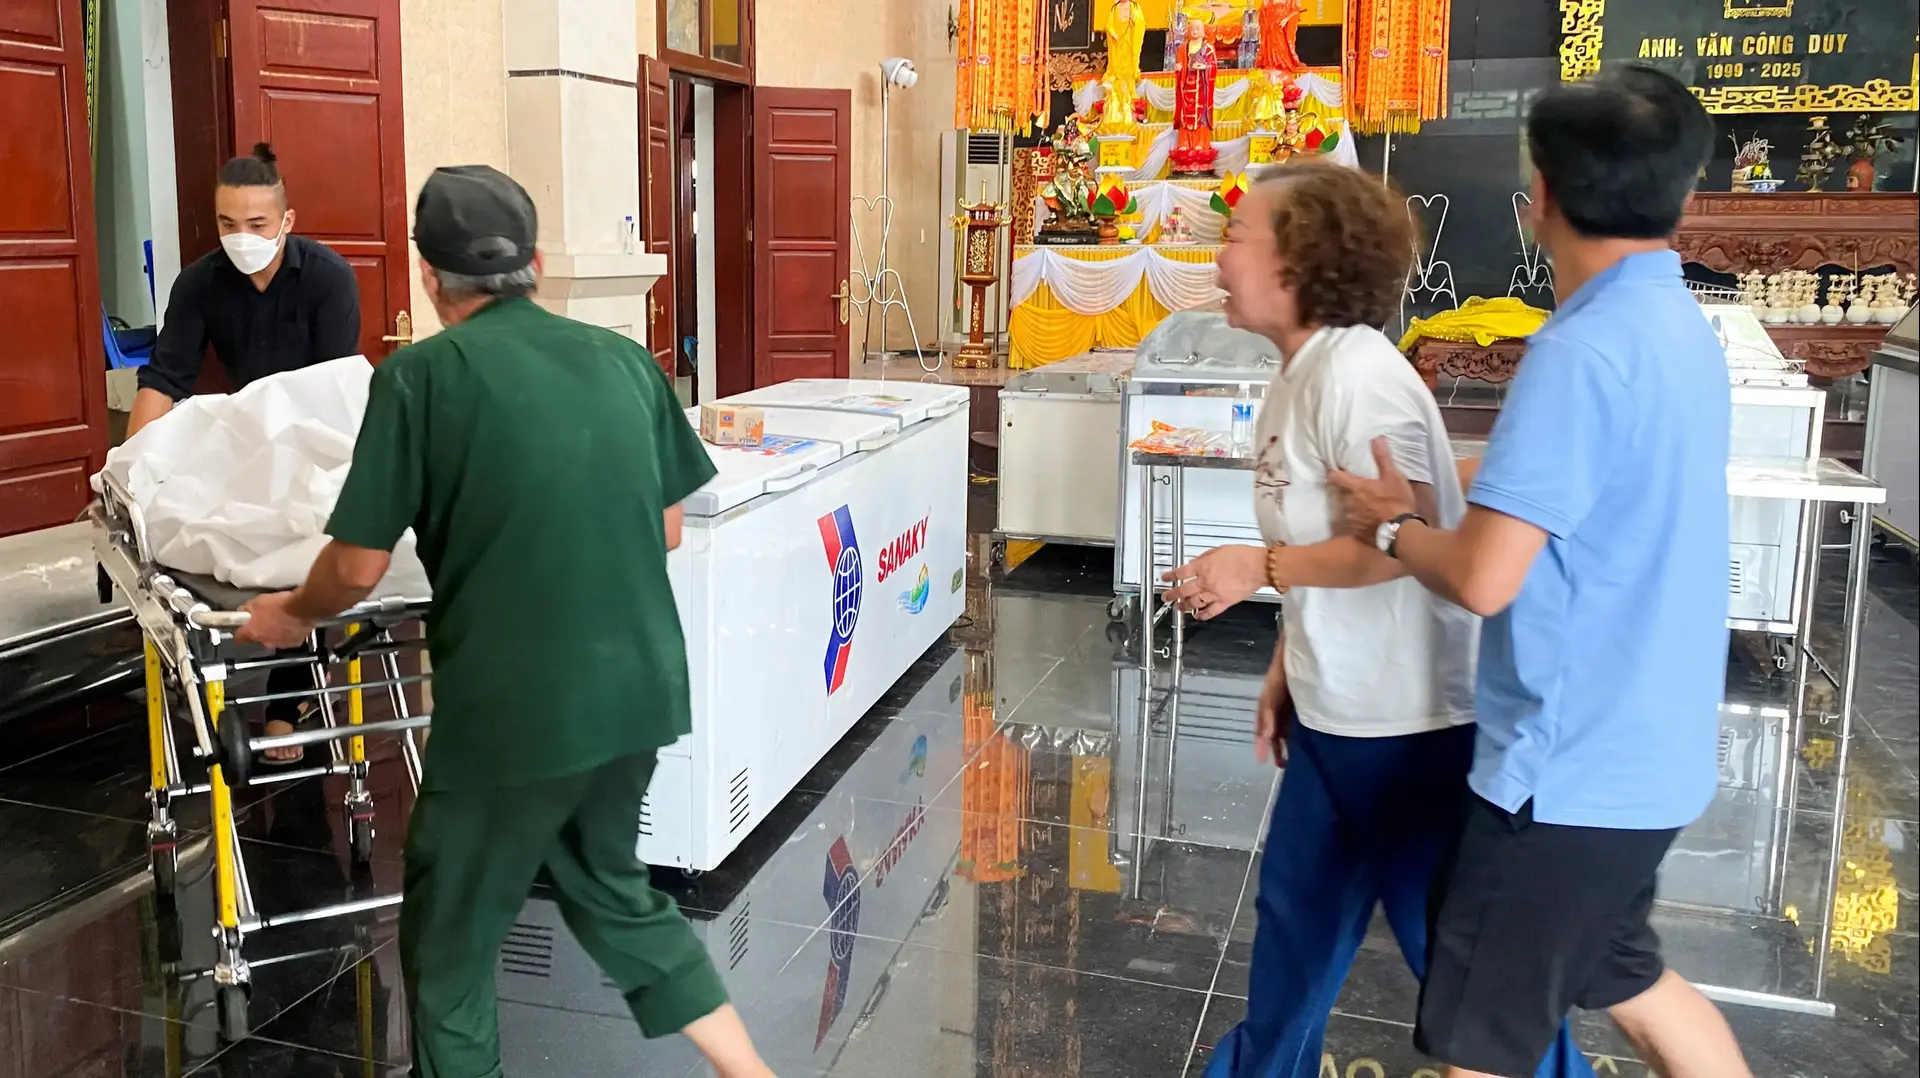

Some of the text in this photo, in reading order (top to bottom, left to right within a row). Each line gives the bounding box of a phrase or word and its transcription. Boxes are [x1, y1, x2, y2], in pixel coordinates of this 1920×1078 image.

[1638, 31, 1848, 58] ANH: VĂN CÔNG DUY
[1706, 62, 1744, 79] 1999
[1760, 62, 1801, 78] 2025
[877, 515, 929, 583] SANAKY
